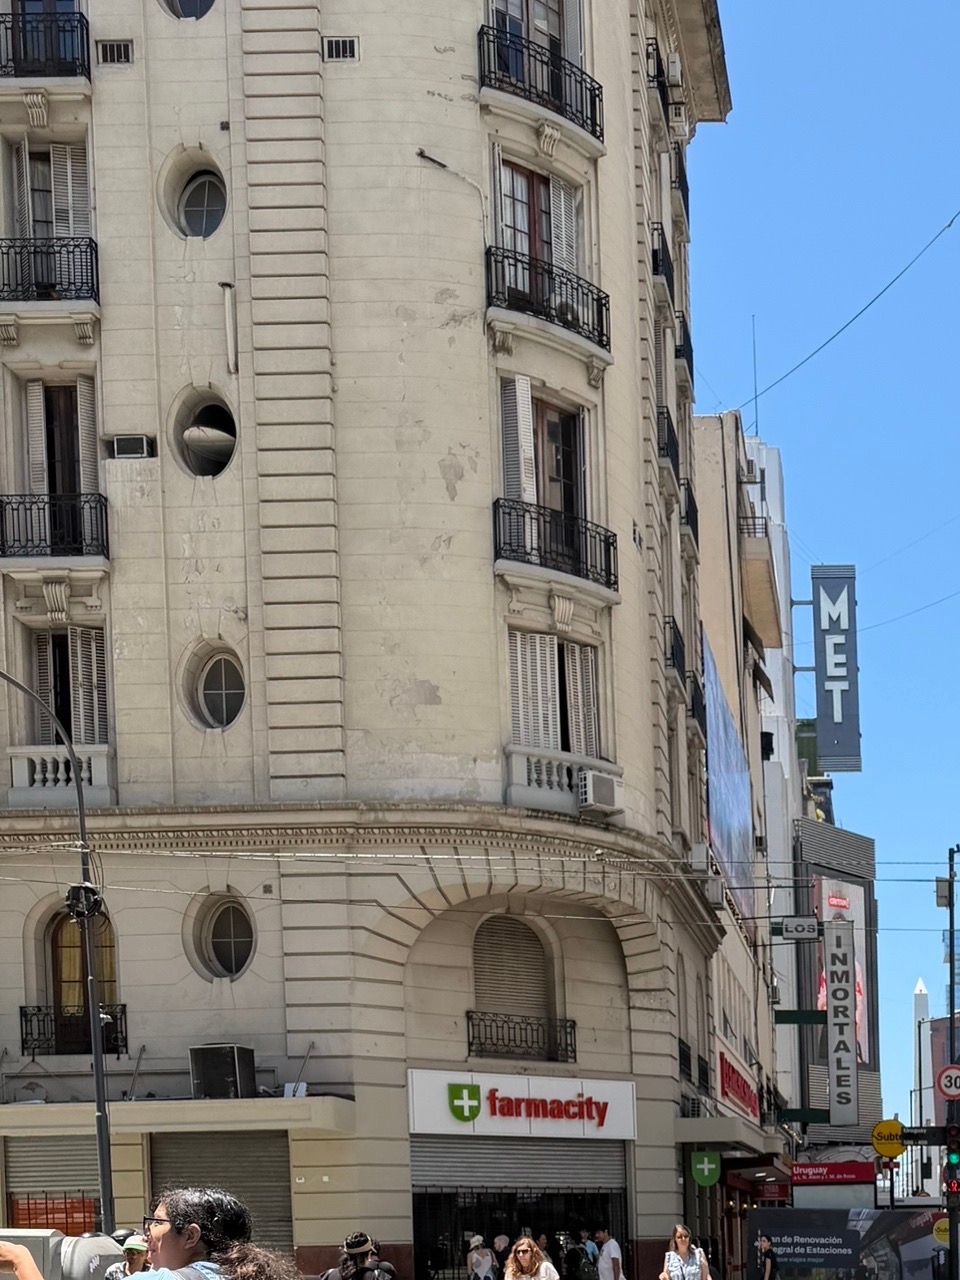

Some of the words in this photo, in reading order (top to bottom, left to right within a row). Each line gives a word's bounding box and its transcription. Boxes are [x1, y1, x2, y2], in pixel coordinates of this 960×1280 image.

[819, 584, 849, 723] MET
[784, 924, 816, 934] LOS
[829, 935, 852, 1105] INMORTALES
[486, 1088, 609, 1127] farmacity
[793, 1166, 828, 1175] Uruguay
[782, 1235, 793, 1243] de
[793, 1235, 842, 1244] Renovación
[773, 1246, 794, 1255] egral
[794, 1246, 805, 1254] de
[806, 1246, 853, 1255] Estaciones
